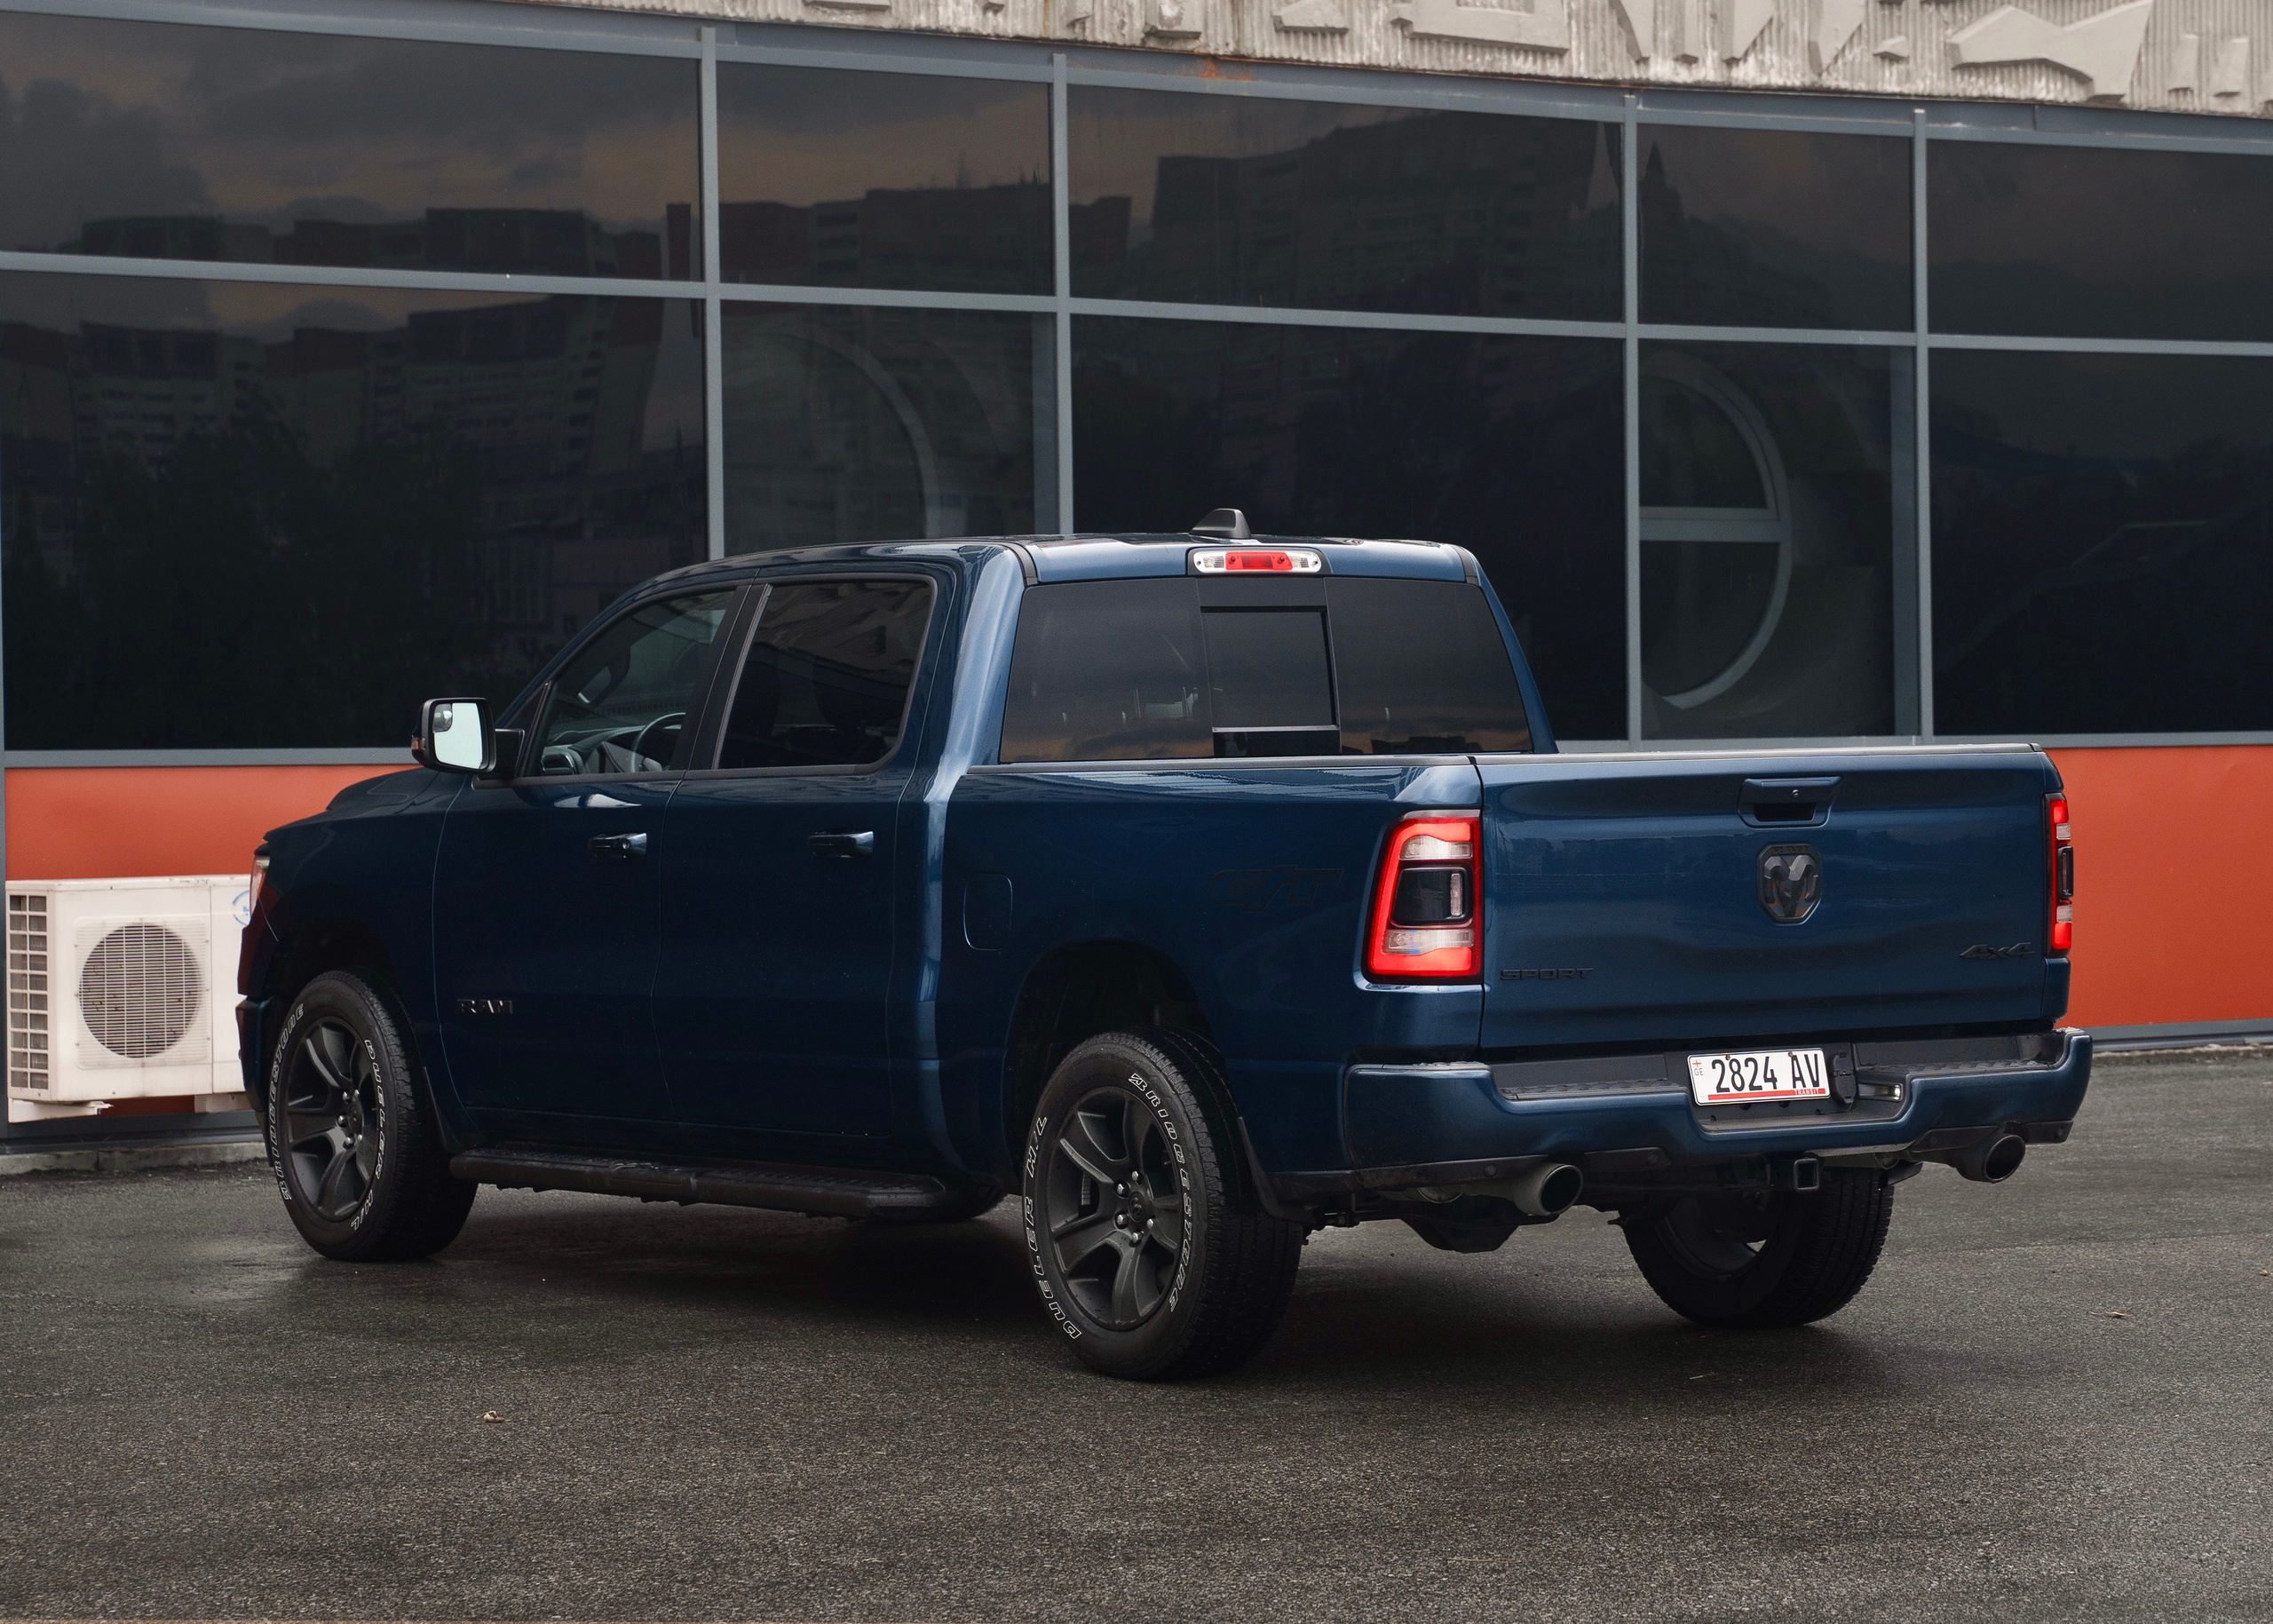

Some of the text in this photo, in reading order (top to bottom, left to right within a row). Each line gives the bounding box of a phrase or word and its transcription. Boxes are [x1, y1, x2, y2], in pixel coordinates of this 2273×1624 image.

[456, 999, 513, 1014] RAM
[1501, 968, 1595, 980] SPORT
[268, 1003, 304, 1200] BRIDGESTONE
[364, 1040, 385, 1180] DUELER
[1694, 1067, 1704, 1076] GE
[1711, 1053, 1820, 1093] 2824 AV
[1128, 1073, 1192, 1312] BRIDGESTONE
[1024, 1196, 1082, 1339] DUELER
